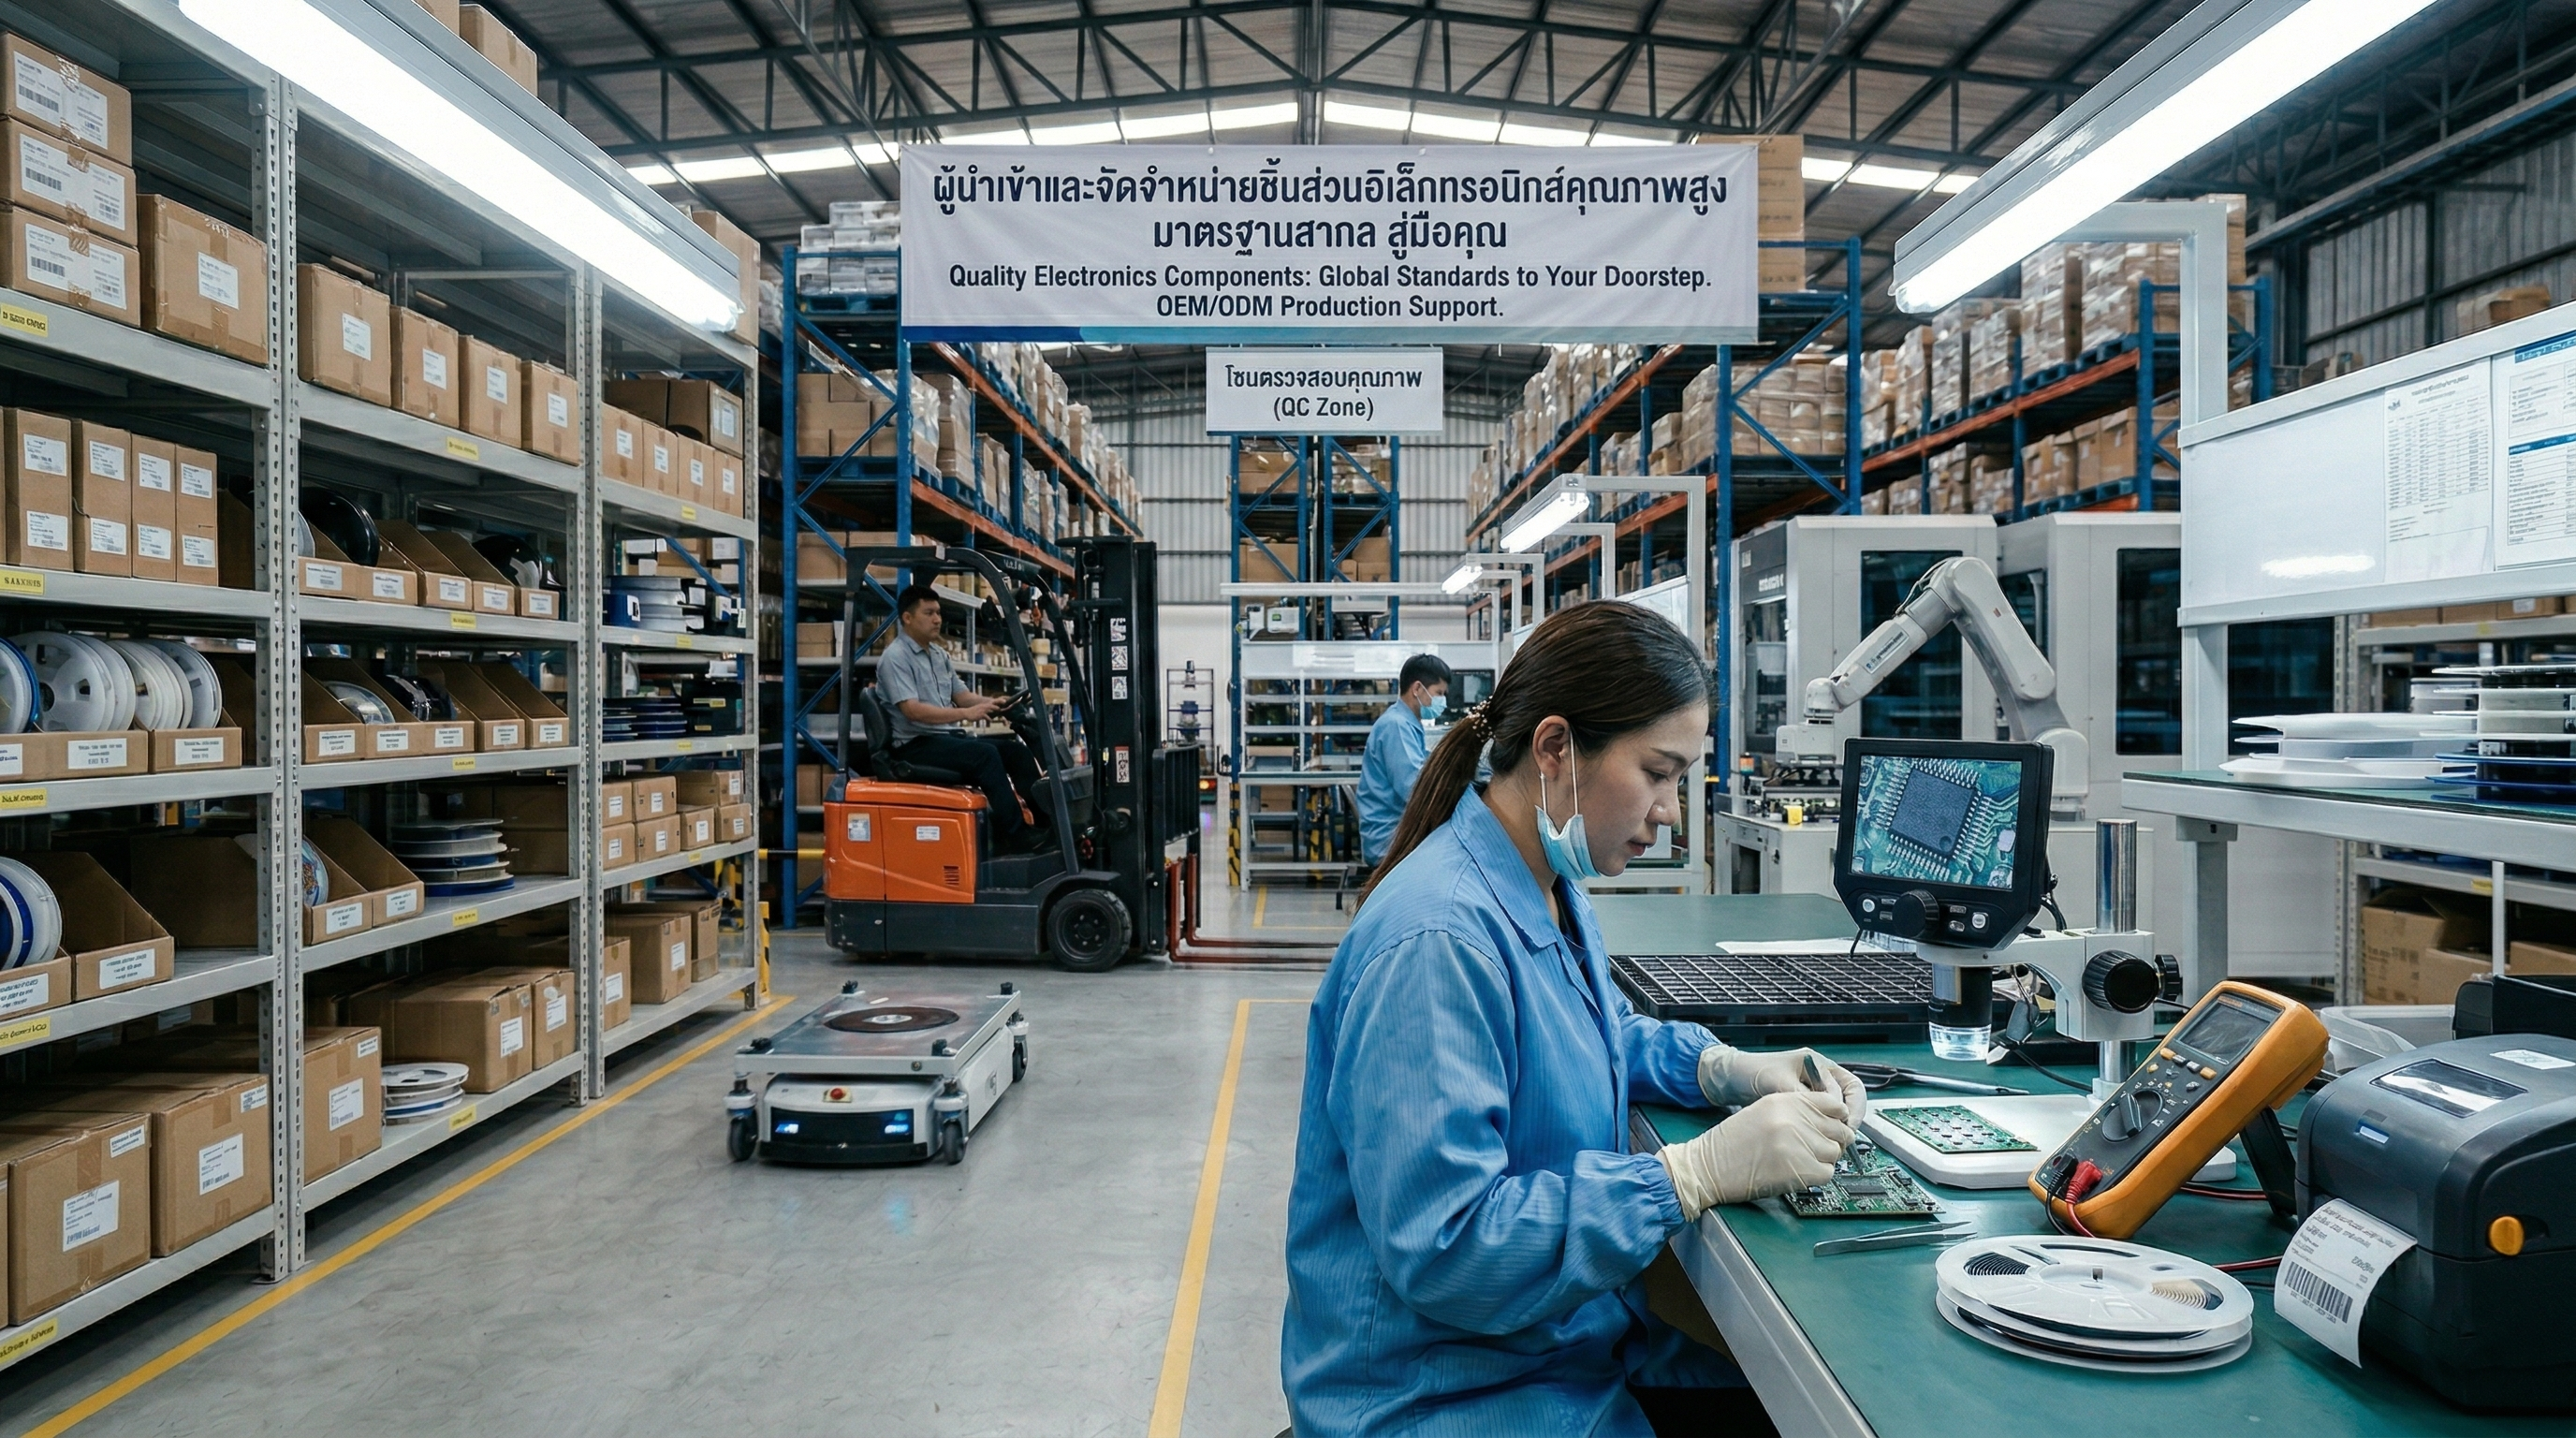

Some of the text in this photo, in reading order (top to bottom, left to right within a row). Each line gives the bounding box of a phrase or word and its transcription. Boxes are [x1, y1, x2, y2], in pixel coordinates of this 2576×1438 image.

[933, 157, 1728, 216] ผู้นำเข้าและจัดจำหน่ายชิ้นส่วนอิเล็กทรอนิกส์คุณภาพสูง
[1154, 210, 1507, 260] มาตรฐานสากล สู่มือคุณ
[949, 264, 1712, 293] Quality Electronics Components: Global Standards to Your Doorstep.
[1156, 295, 1503, 322] OEM/ODM Production Support.
[1224, 364, 1423, 394] โซนตรวจสอบคุณภาพ
[1273, 396, 1374, 422] (QC Zone)
